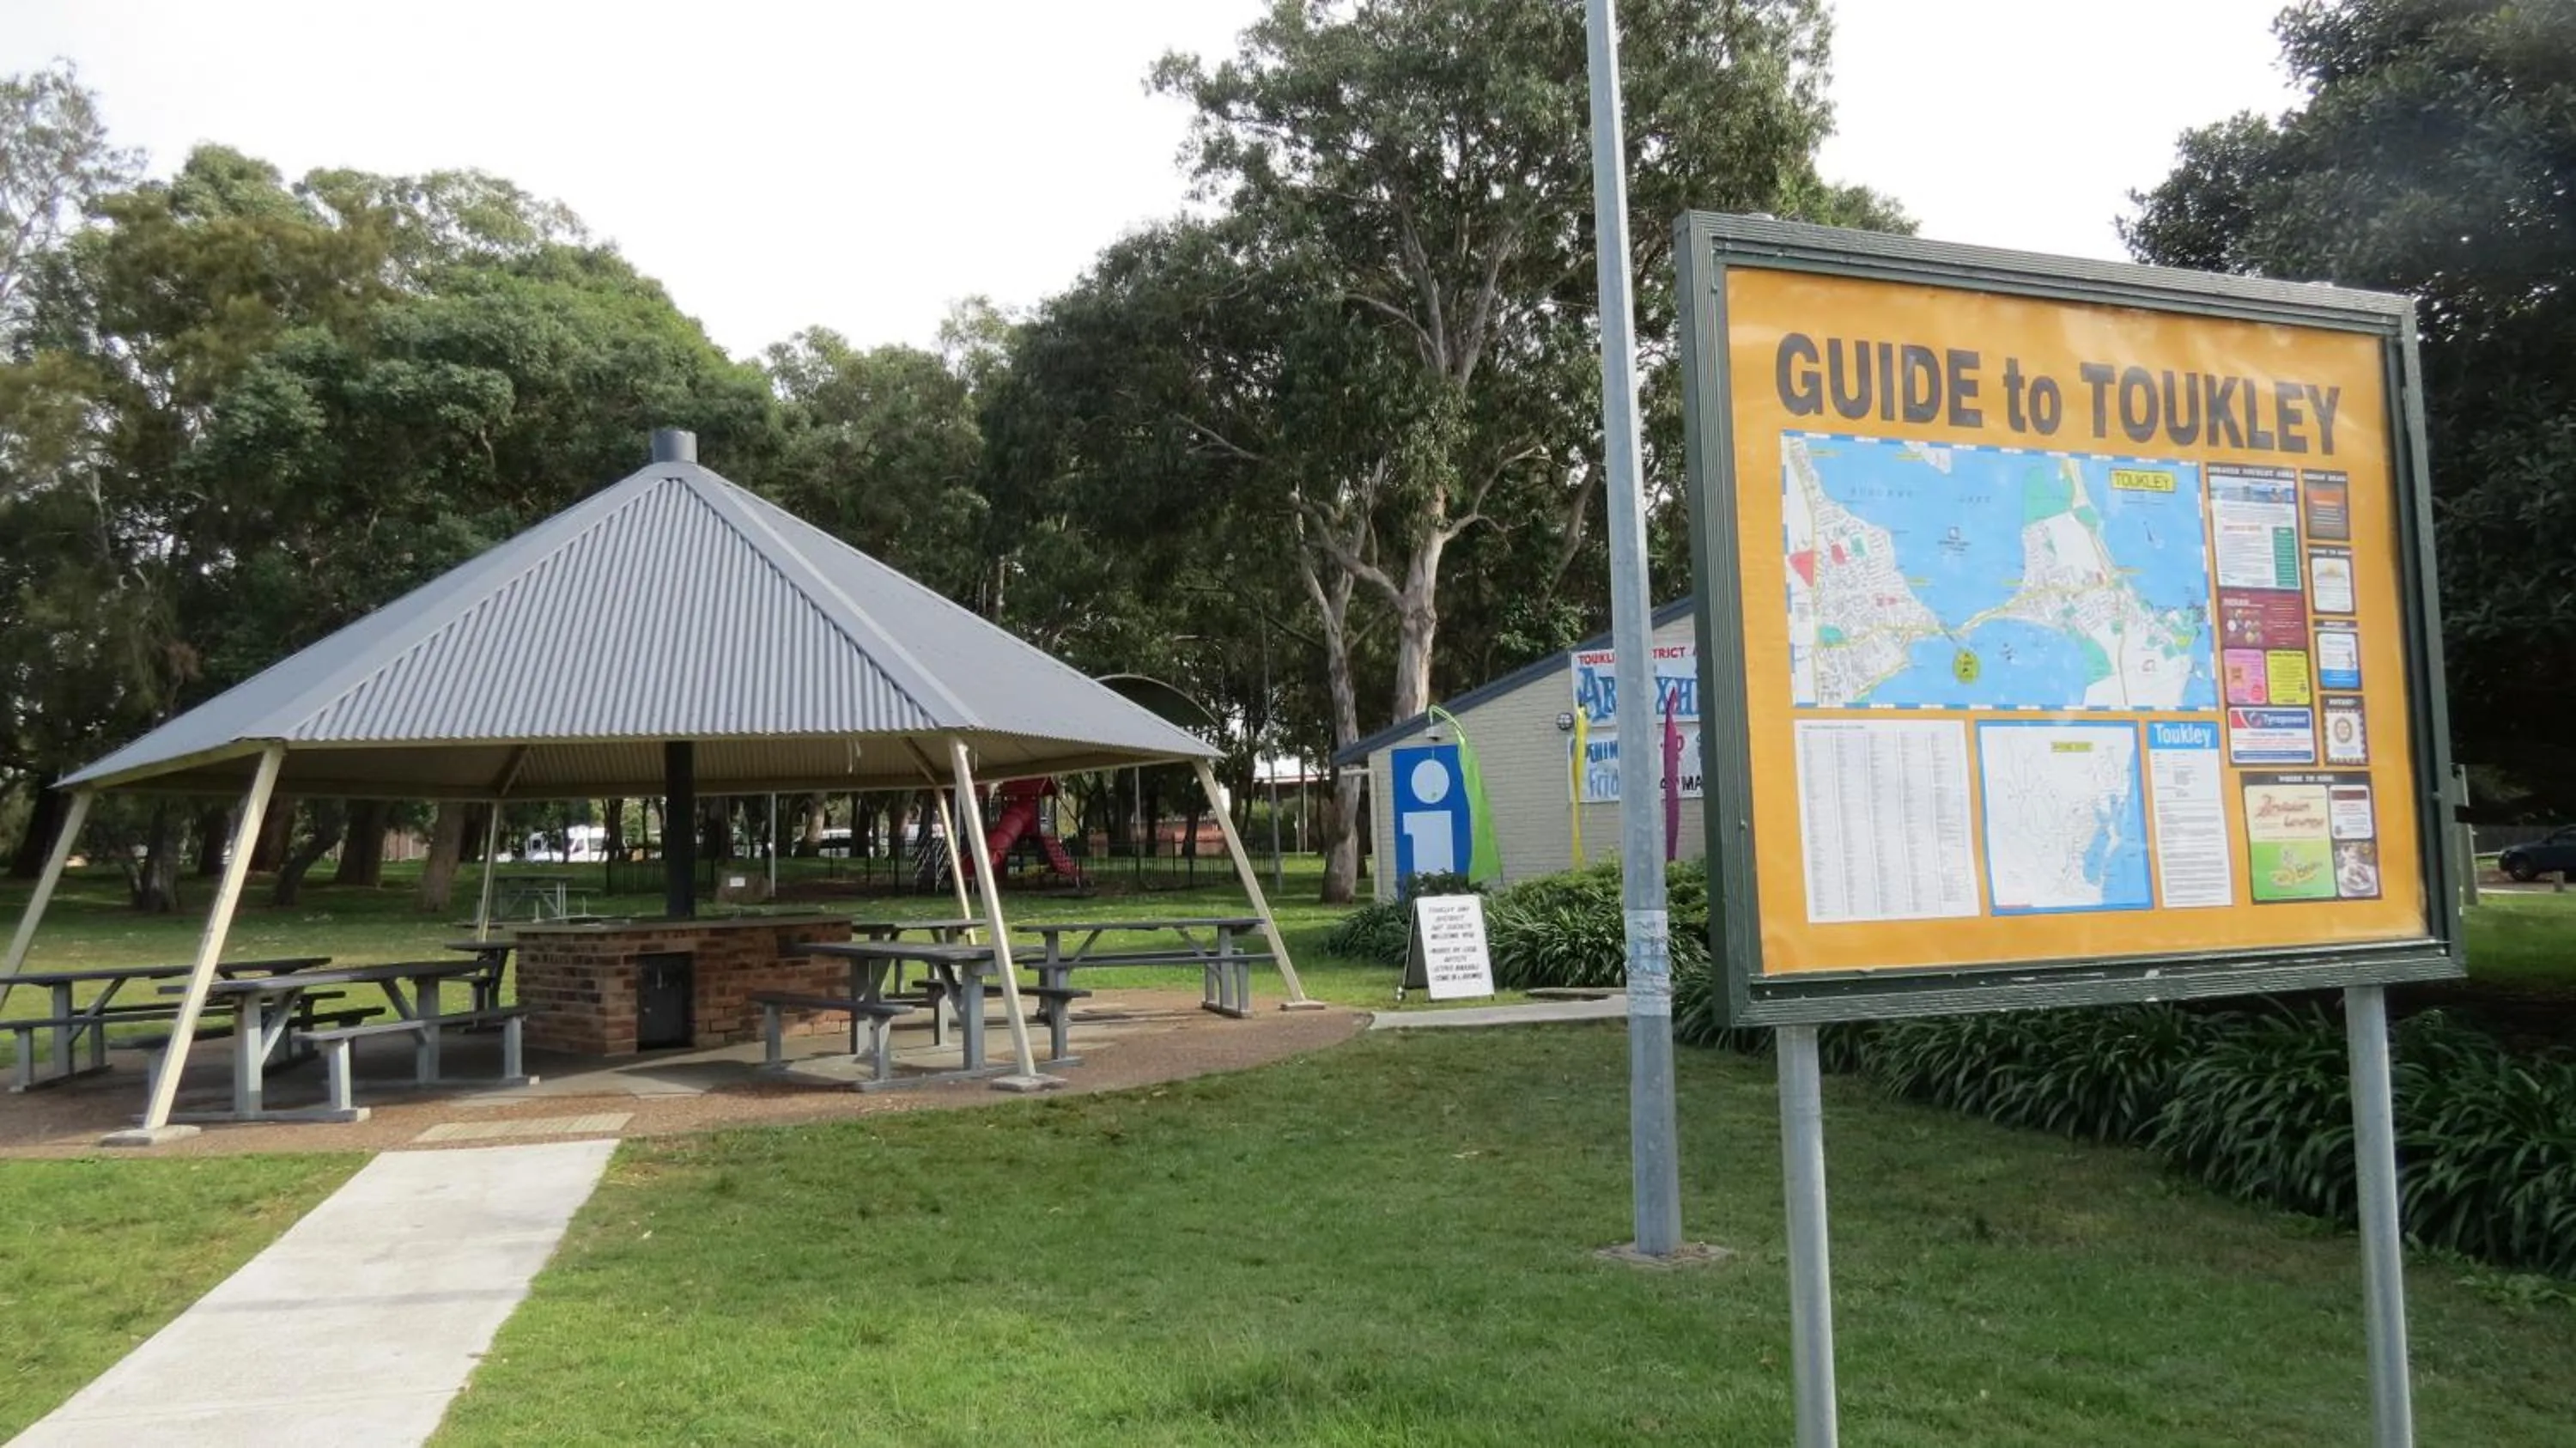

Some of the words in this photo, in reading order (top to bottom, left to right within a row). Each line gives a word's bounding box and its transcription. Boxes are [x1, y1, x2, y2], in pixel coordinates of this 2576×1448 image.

[1776, 332, 1983, 429] GUIDE
[2003, 357, 2062, 436] to
[2080, 362, 2341, 456] TOUKLEY
[2115, 472, 2170, 490] TOUKLEY
[2154, 724, 2212, 747] Toukley
